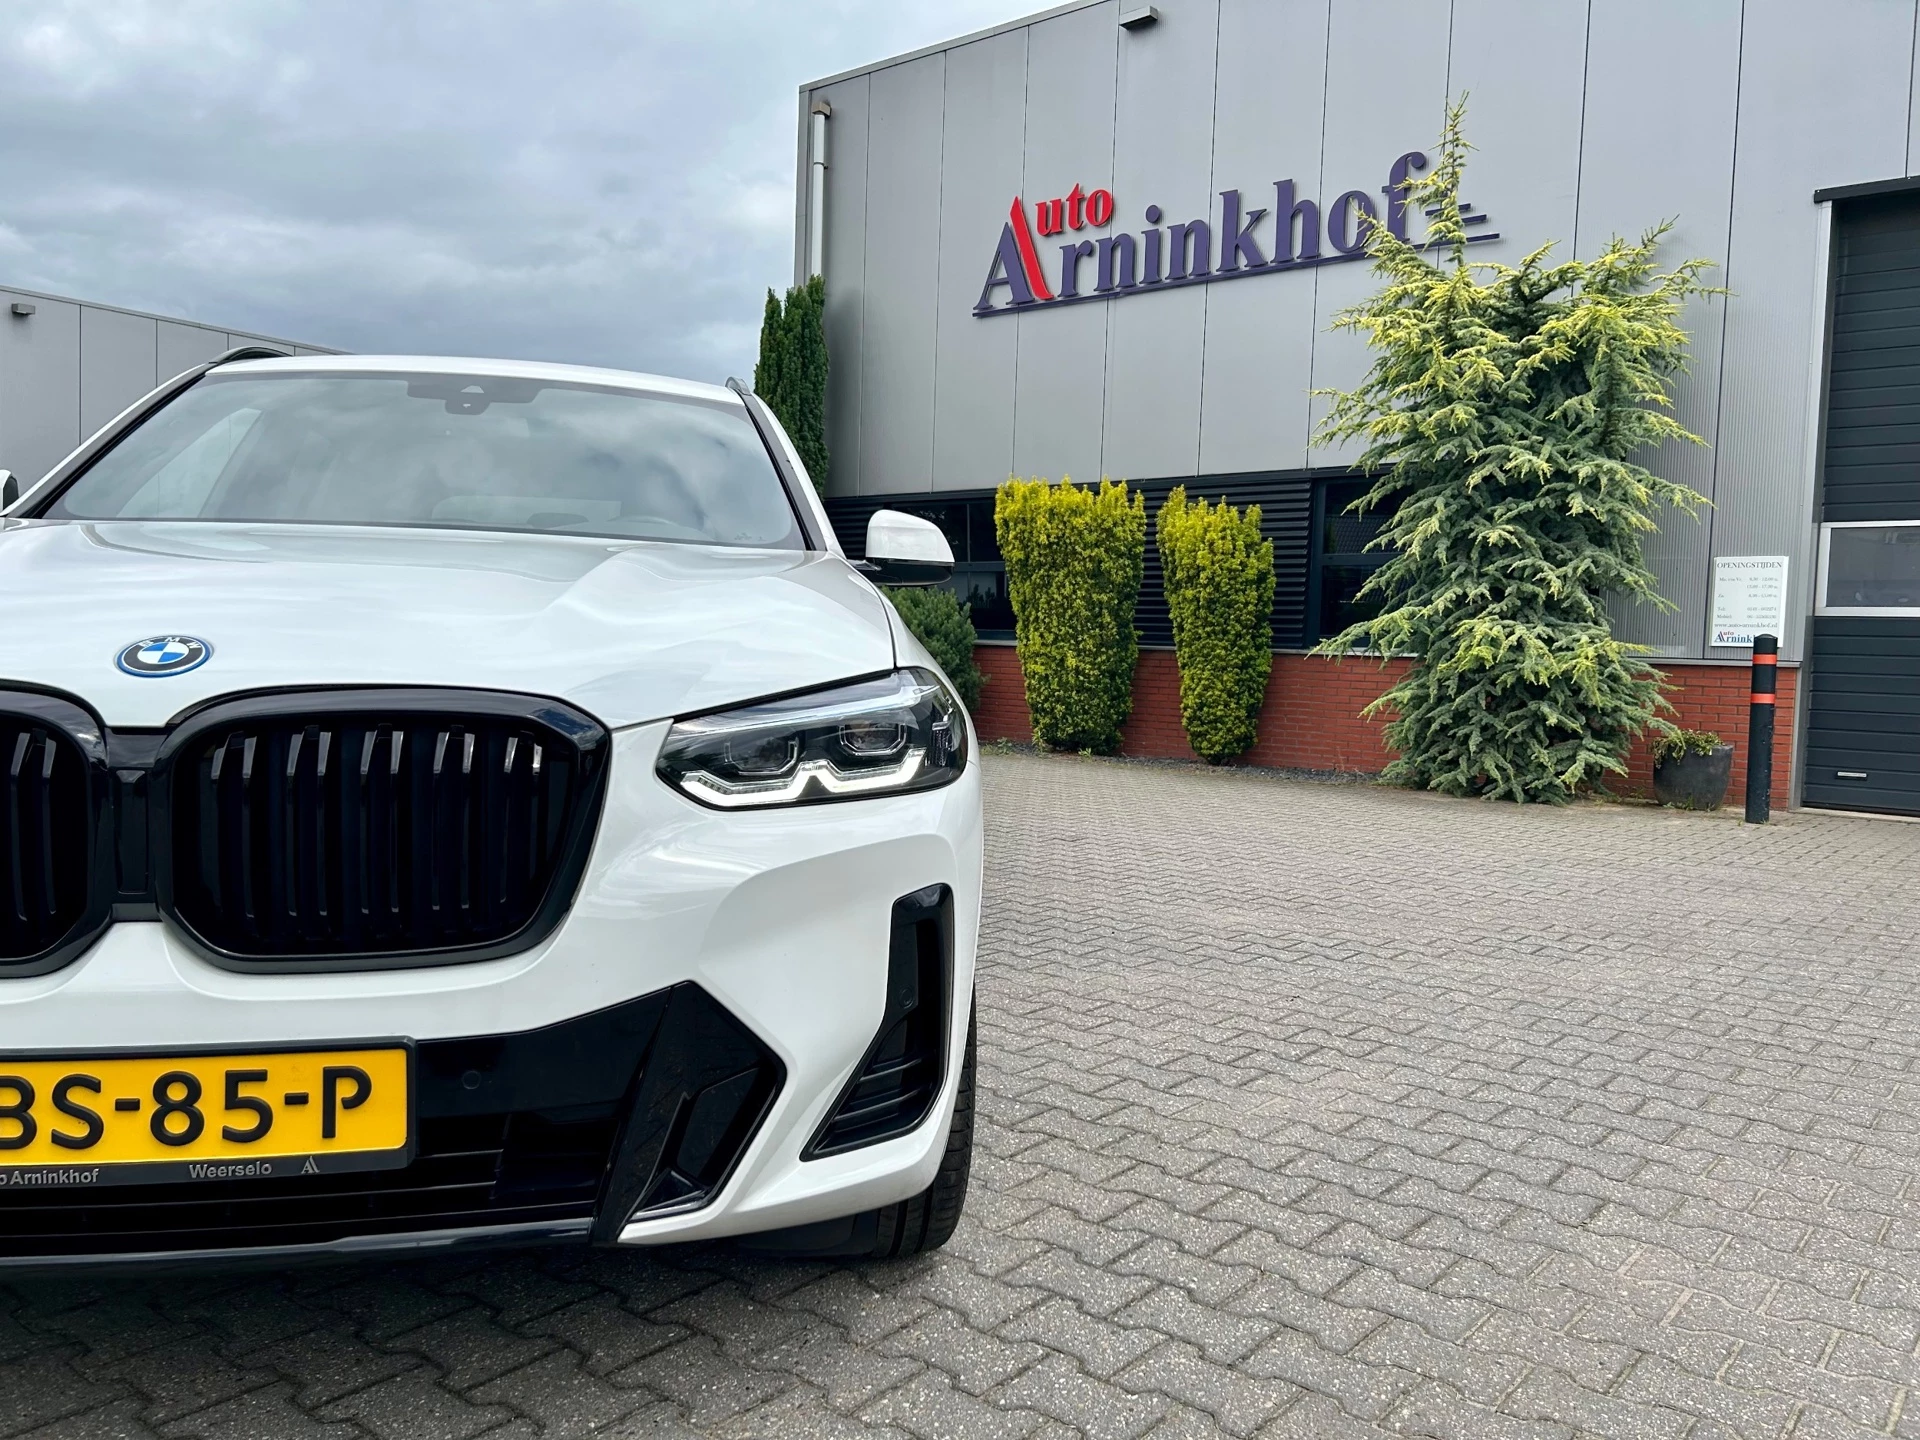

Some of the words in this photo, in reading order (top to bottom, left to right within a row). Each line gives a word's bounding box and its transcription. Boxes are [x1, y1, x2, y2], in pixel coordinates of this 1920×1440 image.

[974, 152, 1427, 311] Arninkhof
[1716, 561, 1782, 569] OPENINGSTIJDEN
[138, 636, 202, 649] BMW
[1714, 632, 1755, 643] Arnink
[0, 1064, 373, 1150] BS-85-P
[10, 1168, 100, 1185] Arninkhof
[189, 1160, 273, 1179] Weerselo
